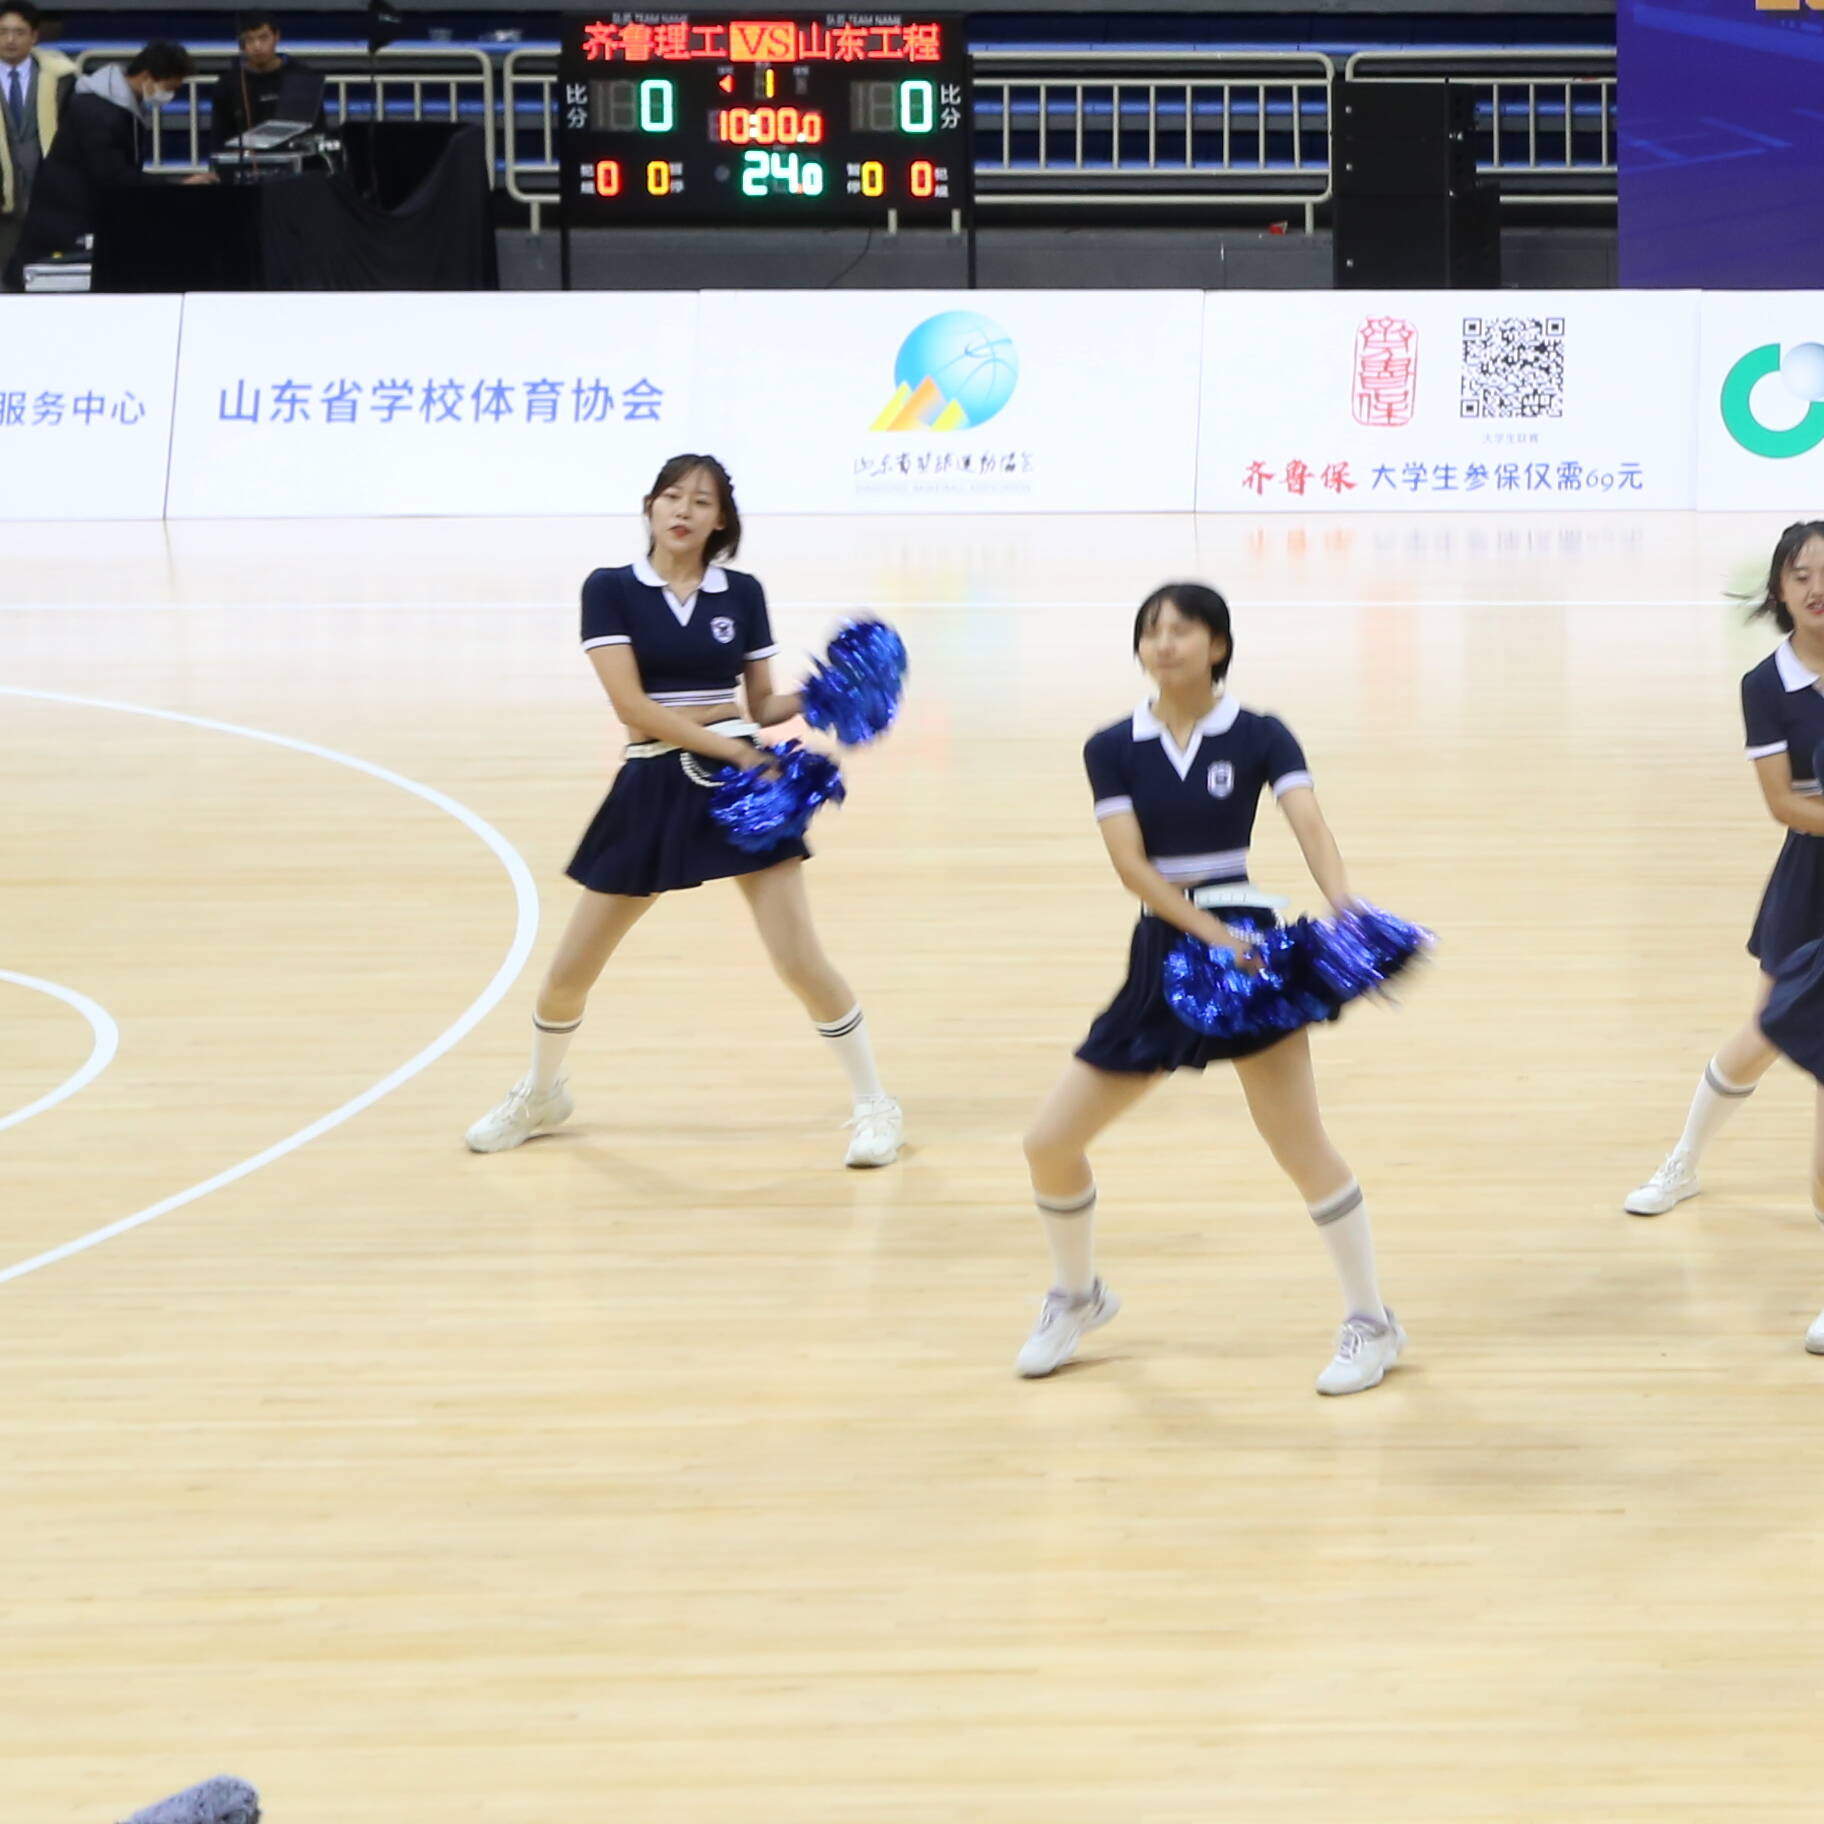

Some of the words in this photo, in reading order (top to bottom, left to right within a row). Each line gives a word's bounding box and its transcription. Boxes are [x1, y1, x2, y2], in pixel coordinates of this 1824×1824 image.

[583, 21, 728, 61] 齐鲁理工
[736, 26, 790, 57] VS
[798, 21, 942, 63] 山东工程
[765, 69, 775, 98] 1
[566, 82, 588, 128] 比分
[640, 79, 674, 132] 0
[900, 80, 934, 133] 0
[939, 83, 961, 129] 比分
[718, 107, 822, 145] 10:00.0
[596, 160, 620, 197] 0
[646, 160, 671, 196] 0
[742, 150, 824, 196] 24.0
[861, 160, 884, 197] 0
[910, 160, 933, 197] 0
[0, 390, 146, 427] 服务中心
[217, 376, 666, 425] 山东省学校体育协会
[1241, 458, 1358, 496] 齐鲁保
[1371, 460, 1644, 494] 大学生参保仅需69元
